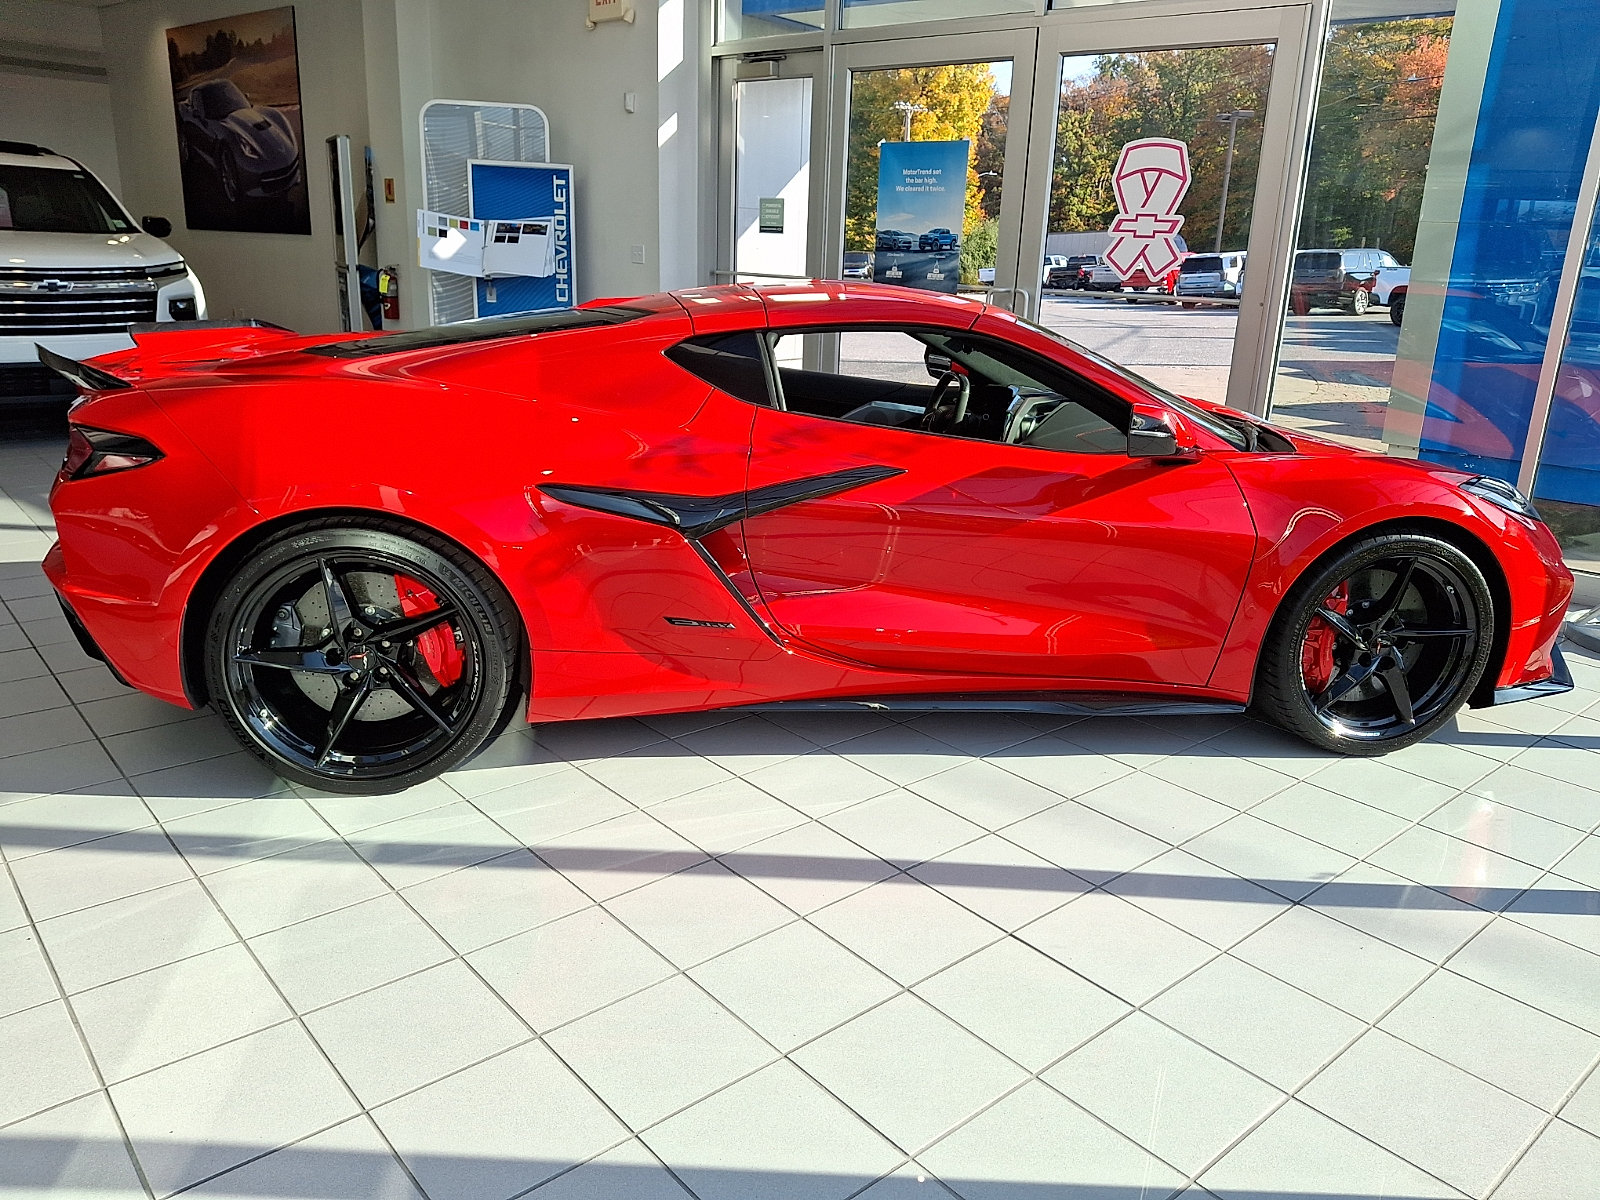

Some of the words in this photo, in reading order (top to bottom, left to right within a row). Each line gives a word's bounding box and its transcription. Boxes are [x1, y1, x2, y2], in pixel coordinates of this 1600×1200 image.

[902, 168, 932, 176] MotorTrend
[553, 174, 569, 302] CHEVROLET
[453, 577, 494, 632] MICHELIN
